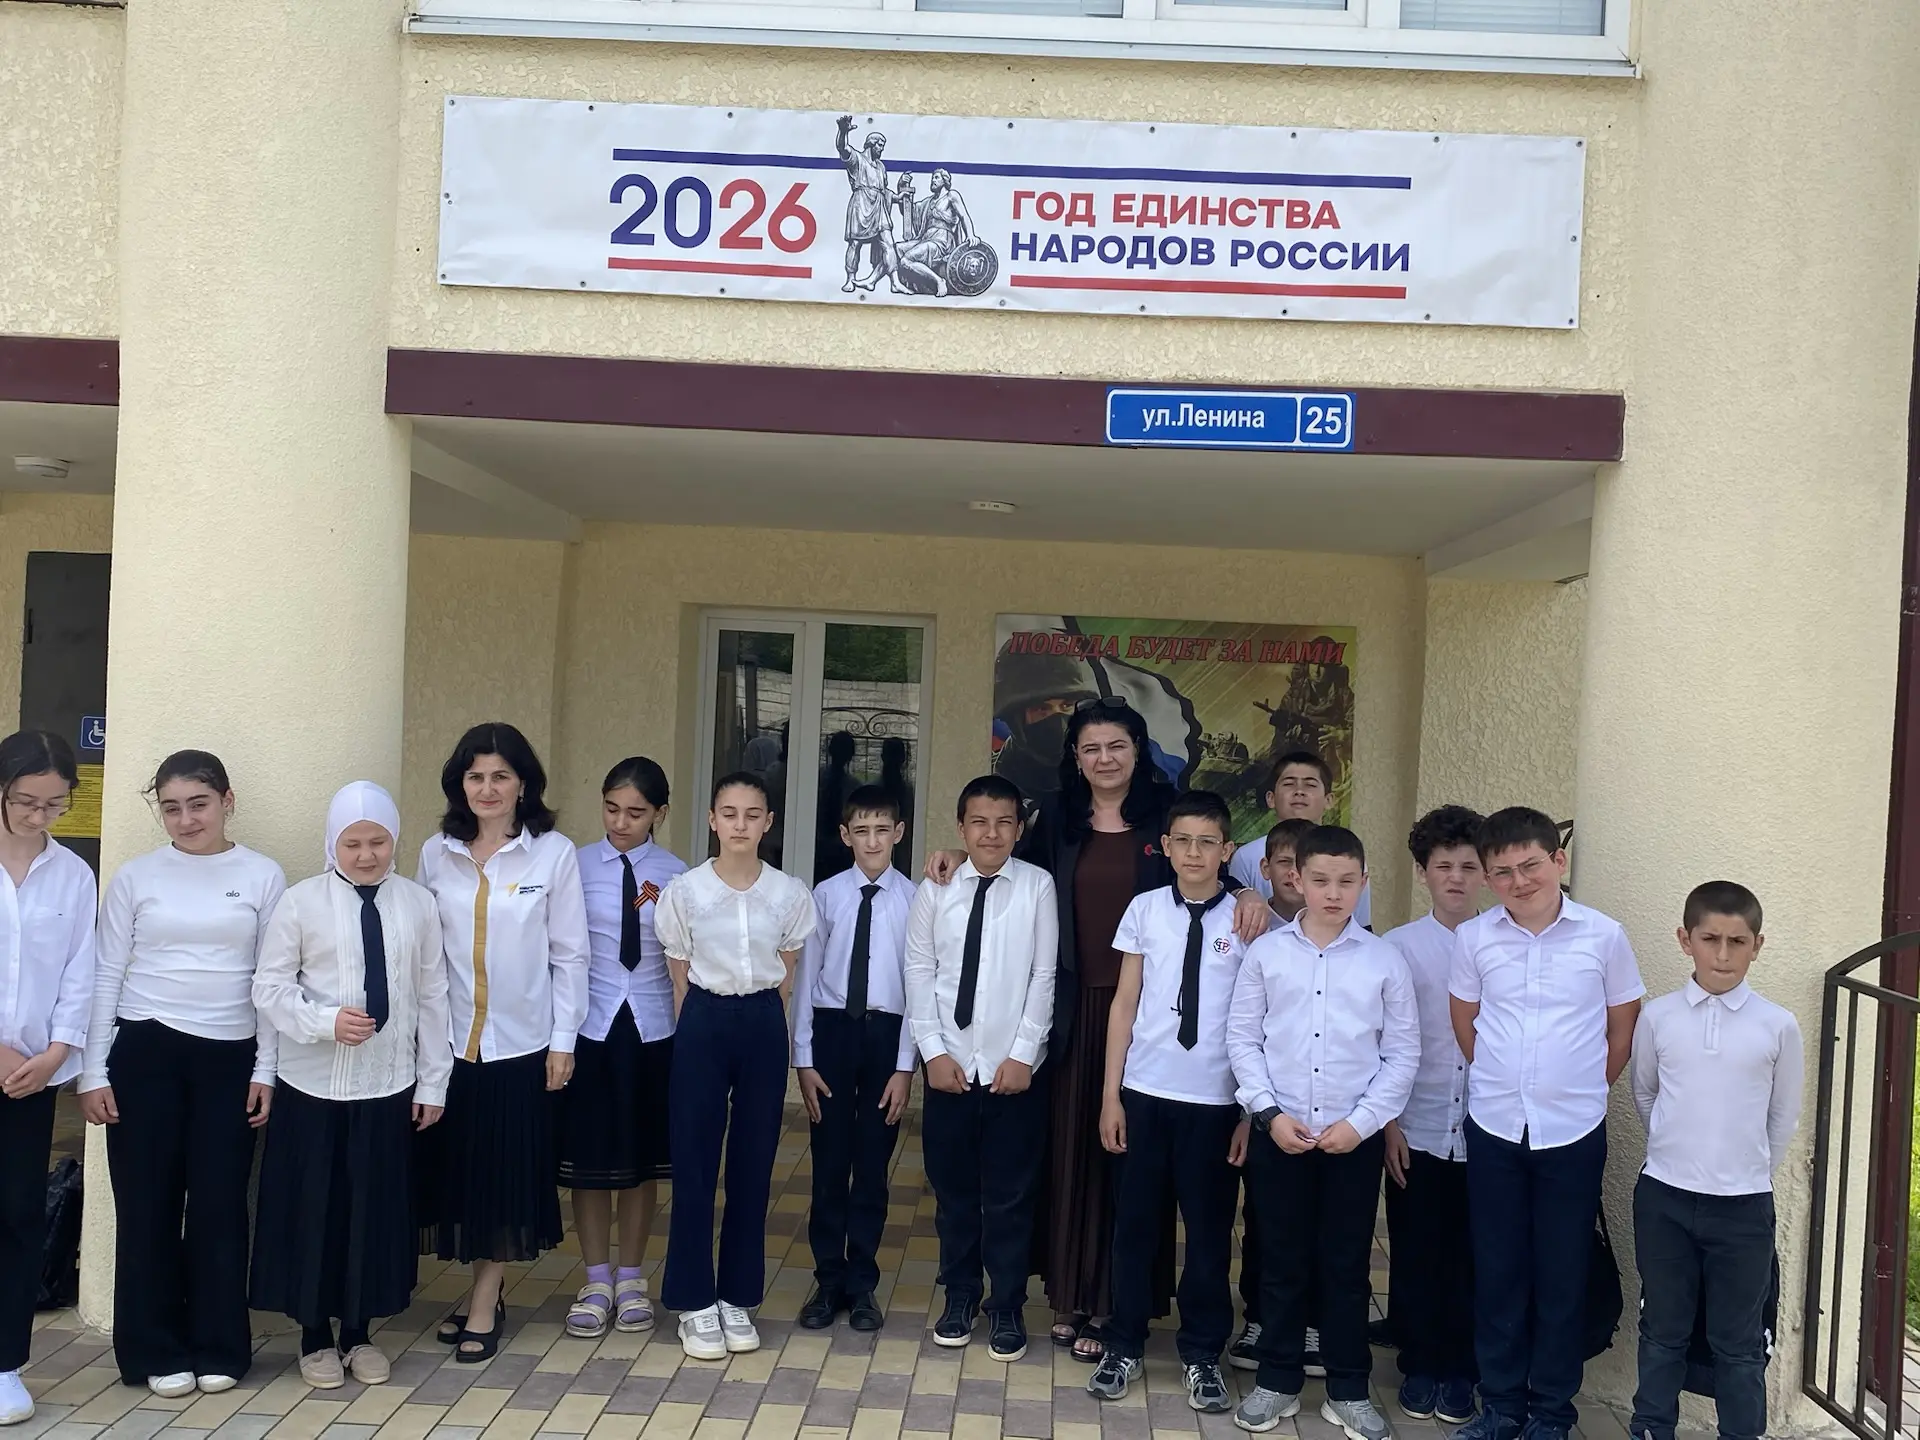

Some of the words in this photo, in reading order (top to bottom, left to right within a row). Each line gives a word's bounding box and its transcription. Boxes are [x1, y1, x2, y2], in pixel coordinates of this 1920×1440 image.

[609, 173, 817, 253] 2026
[1012, 190, 1096, 228] ГОД
[1113, 193, 1341, 230] ЕДИНСТВА
[1010, 232, 1215, 270] НАРОДОВ
[1230, 239, 1410, 273] РОССИИ
[1142, 403, 1265, 432] ул.Ленина
[1305, 406, 1342, 435] 25
[1008, 631, 1119, 660] ПОБЕДА
[1125, 635, 1216, 664] БУДЕТ
[1218, 639, 1255, 663] ЗА
[1258, 641, 1347, 665] НАМИ
